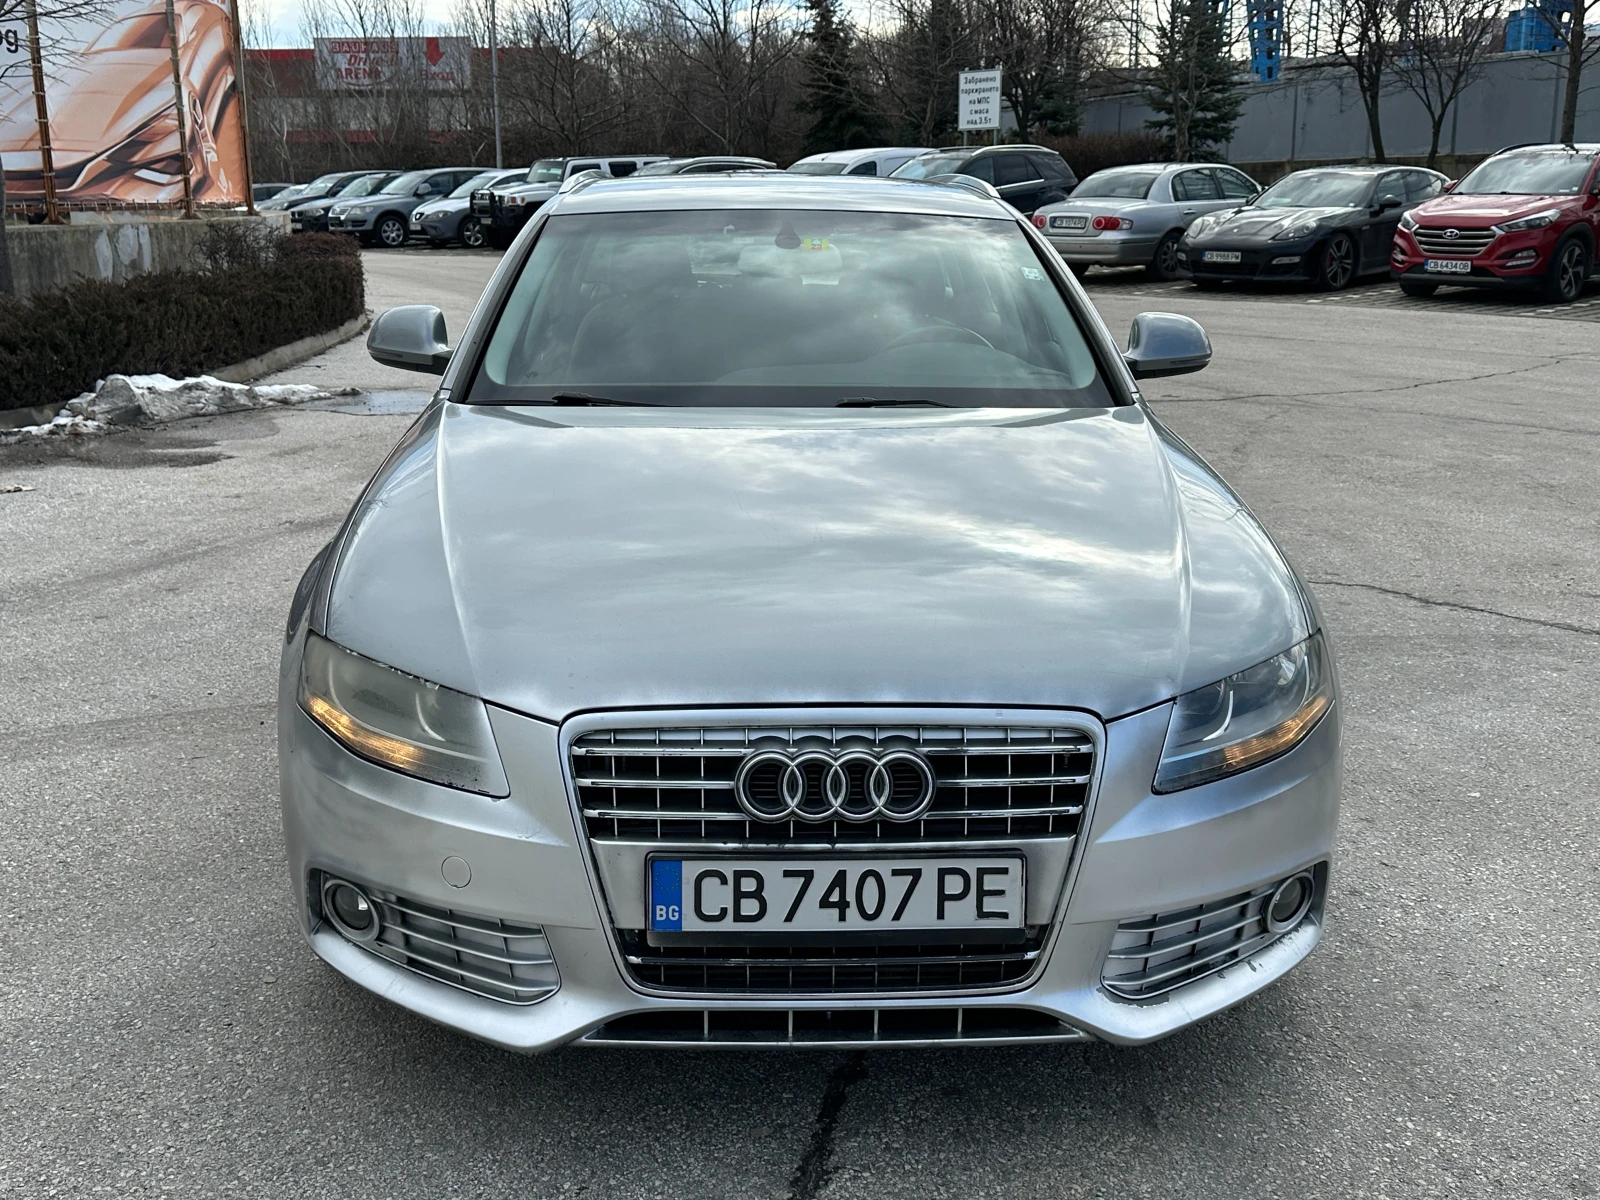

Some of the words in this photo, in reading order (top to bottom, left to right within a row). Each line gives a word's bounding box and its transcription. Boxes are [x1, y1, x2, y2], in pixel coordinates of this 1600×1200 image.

[964, 76, 996, 85] Забранено
[961, 86, 999, 95] паркирането
[977, 96, 990, 104] МПС
[1429, 260, 1439, 269] CB
[1440, 261, 1458, 270] 6434
[693, 868, 768, 923] CB
[782, 868, 923, 923] 7407
[936, 866, 1010, 921] PE
[655, 905, 680, 921] BG
